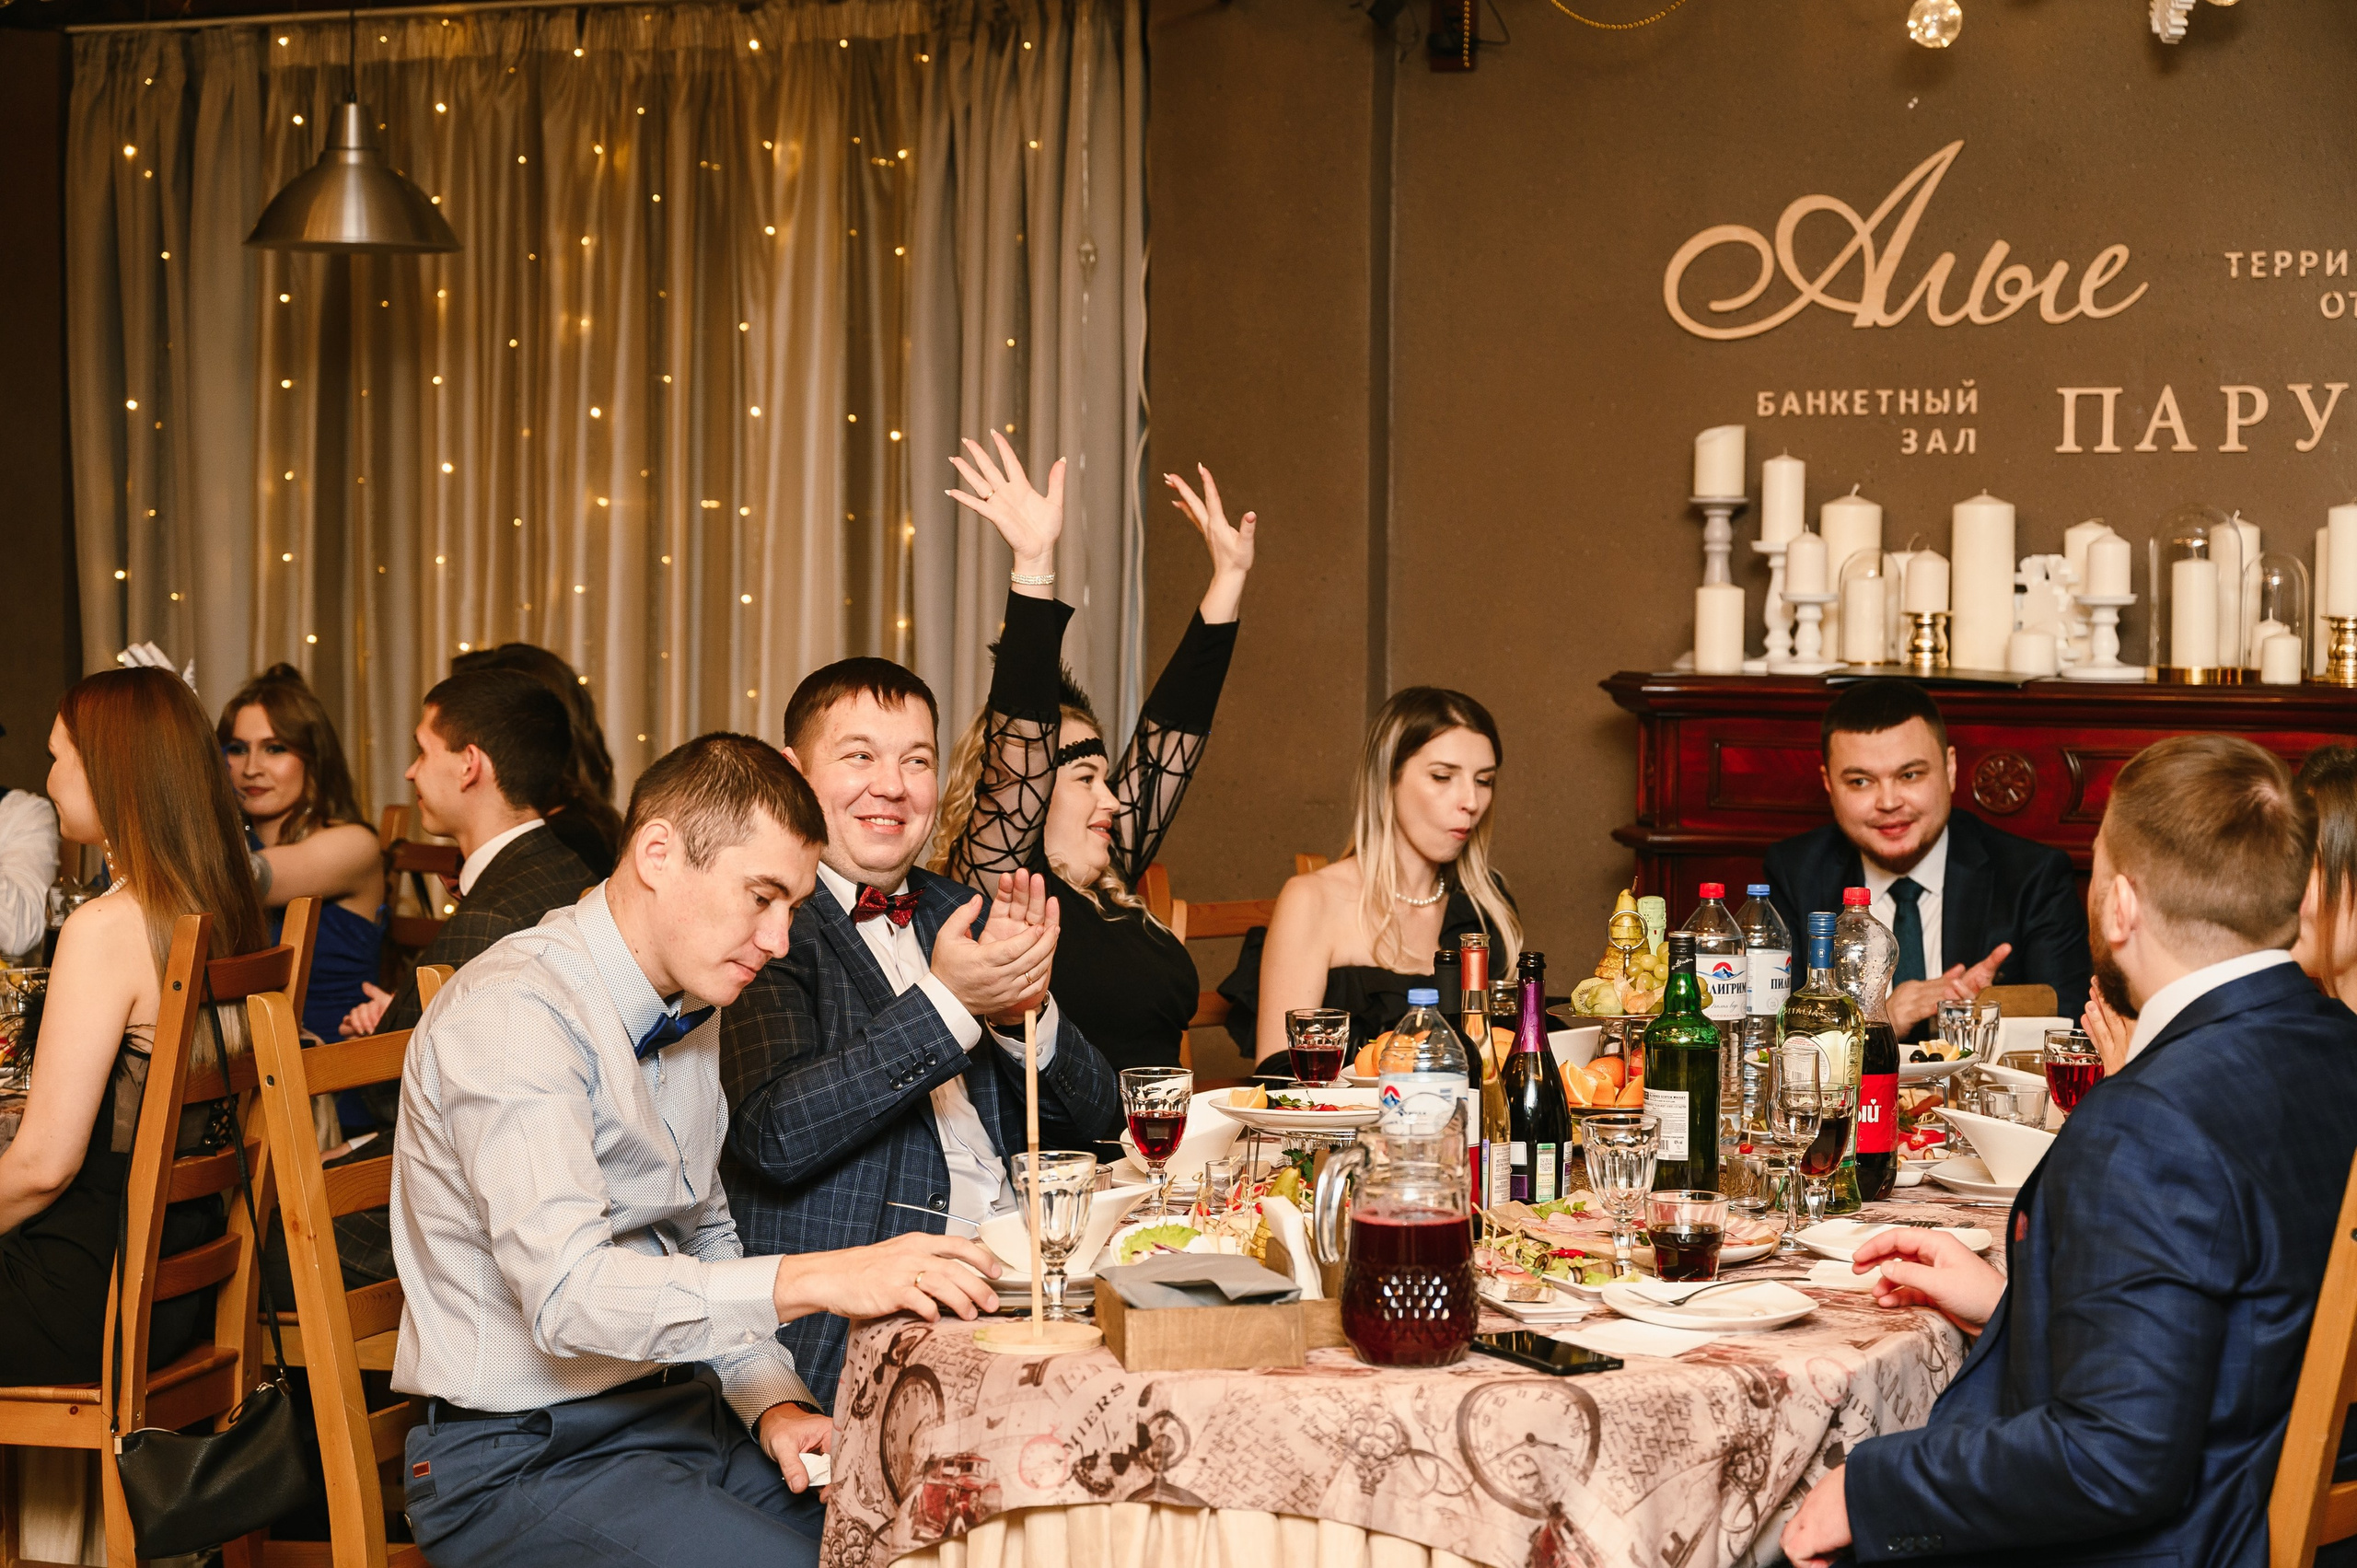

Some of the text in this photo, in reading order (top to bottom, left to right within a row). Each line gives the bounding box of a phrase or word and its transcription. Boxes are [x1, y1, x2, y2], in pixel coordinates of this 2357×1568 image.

[1664, 140, 2149, 340] Алые
[2223, 249, 2357, 278] ТЕРРИ
[1756, 378, 1979, 417] БАНКЕТНЫЙ
[2055, 382, 2350, 453] ПАРУ
[1900, 428, 1977, 454] ЗАЛ
[1707, 981, 1747, 994] ЛИГРИМ
